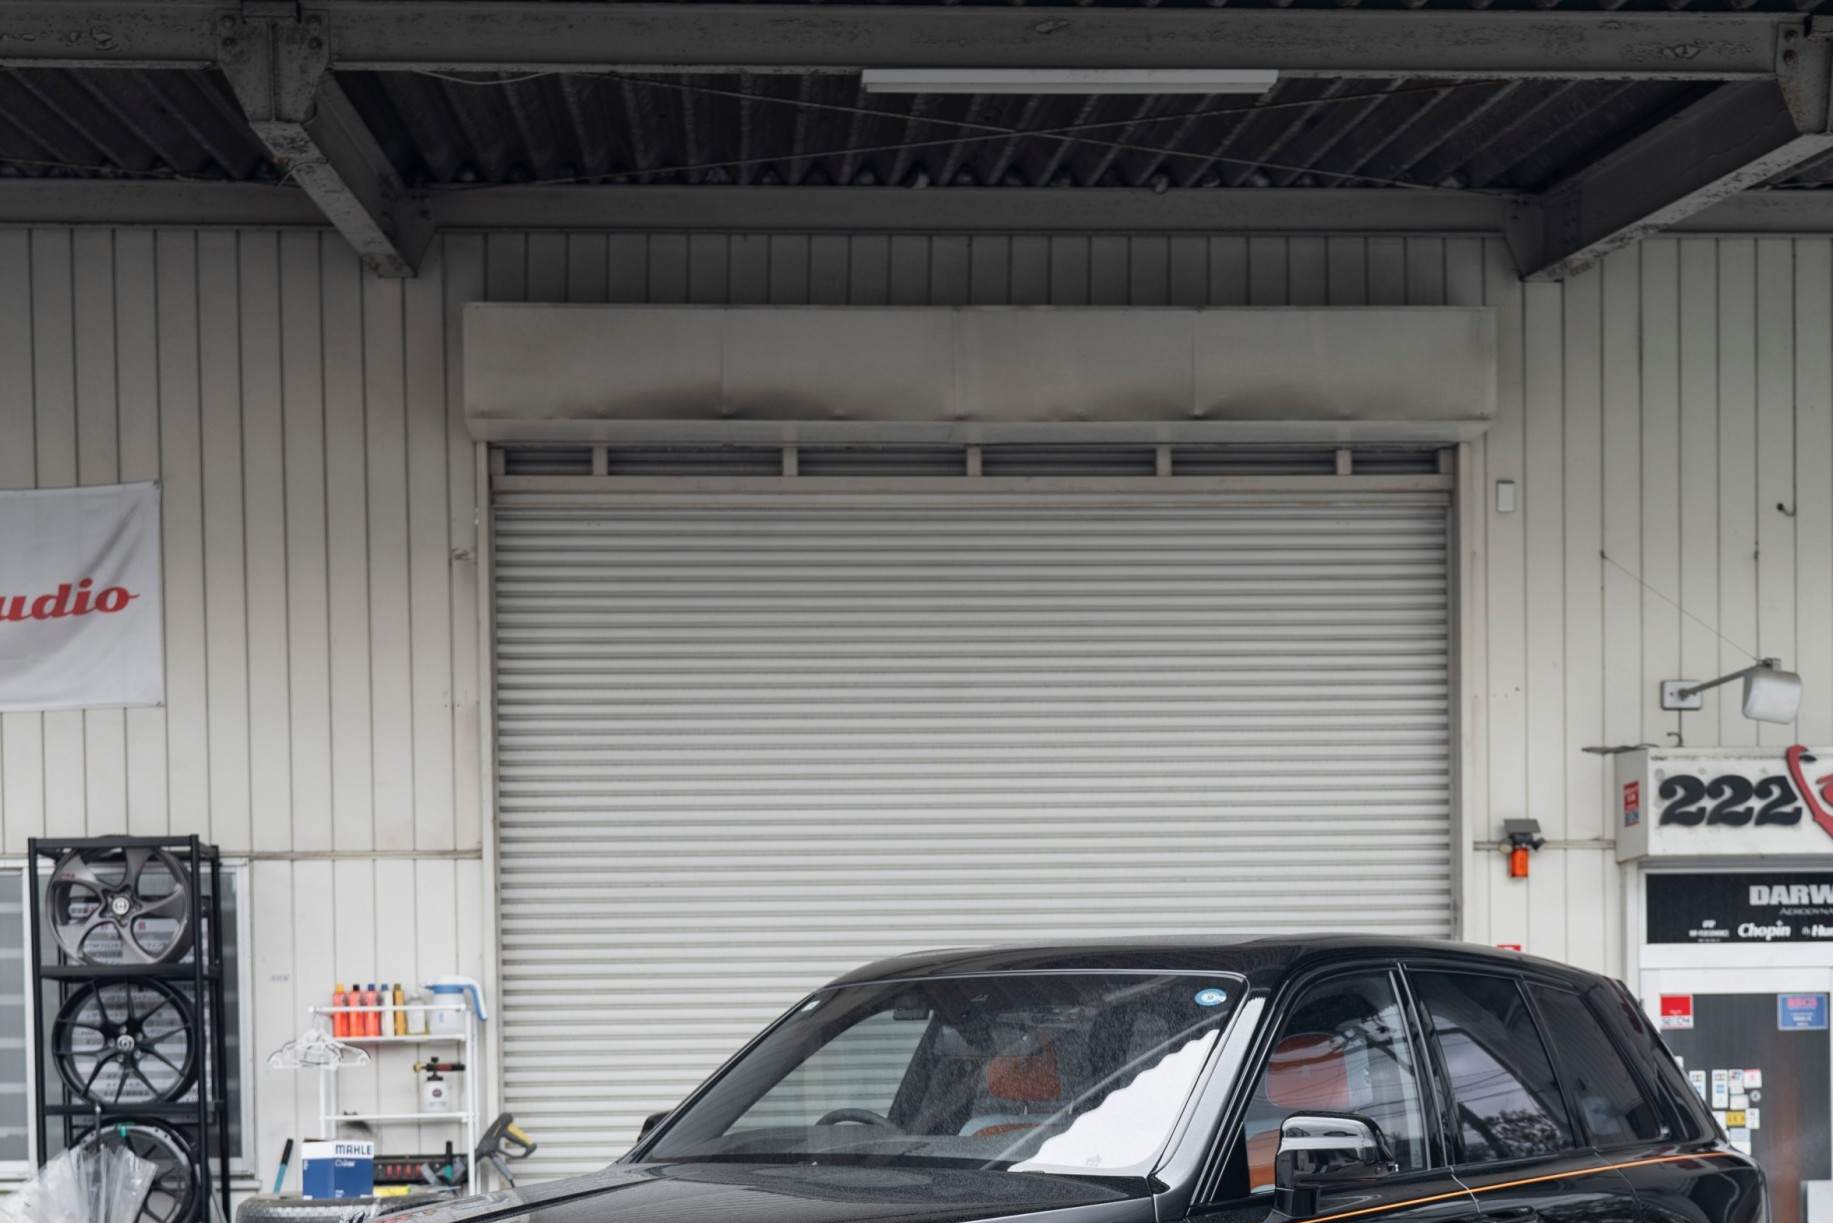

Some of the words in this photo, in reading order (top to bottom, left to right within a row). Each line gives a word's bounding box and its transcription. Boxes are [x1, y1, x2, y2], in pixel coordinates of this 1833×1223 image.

[1658, 774, 1803, 827] 222
[1737, 919, 1792, 941] Chopin
[335, 1144, 372, 1155] MAHLE
